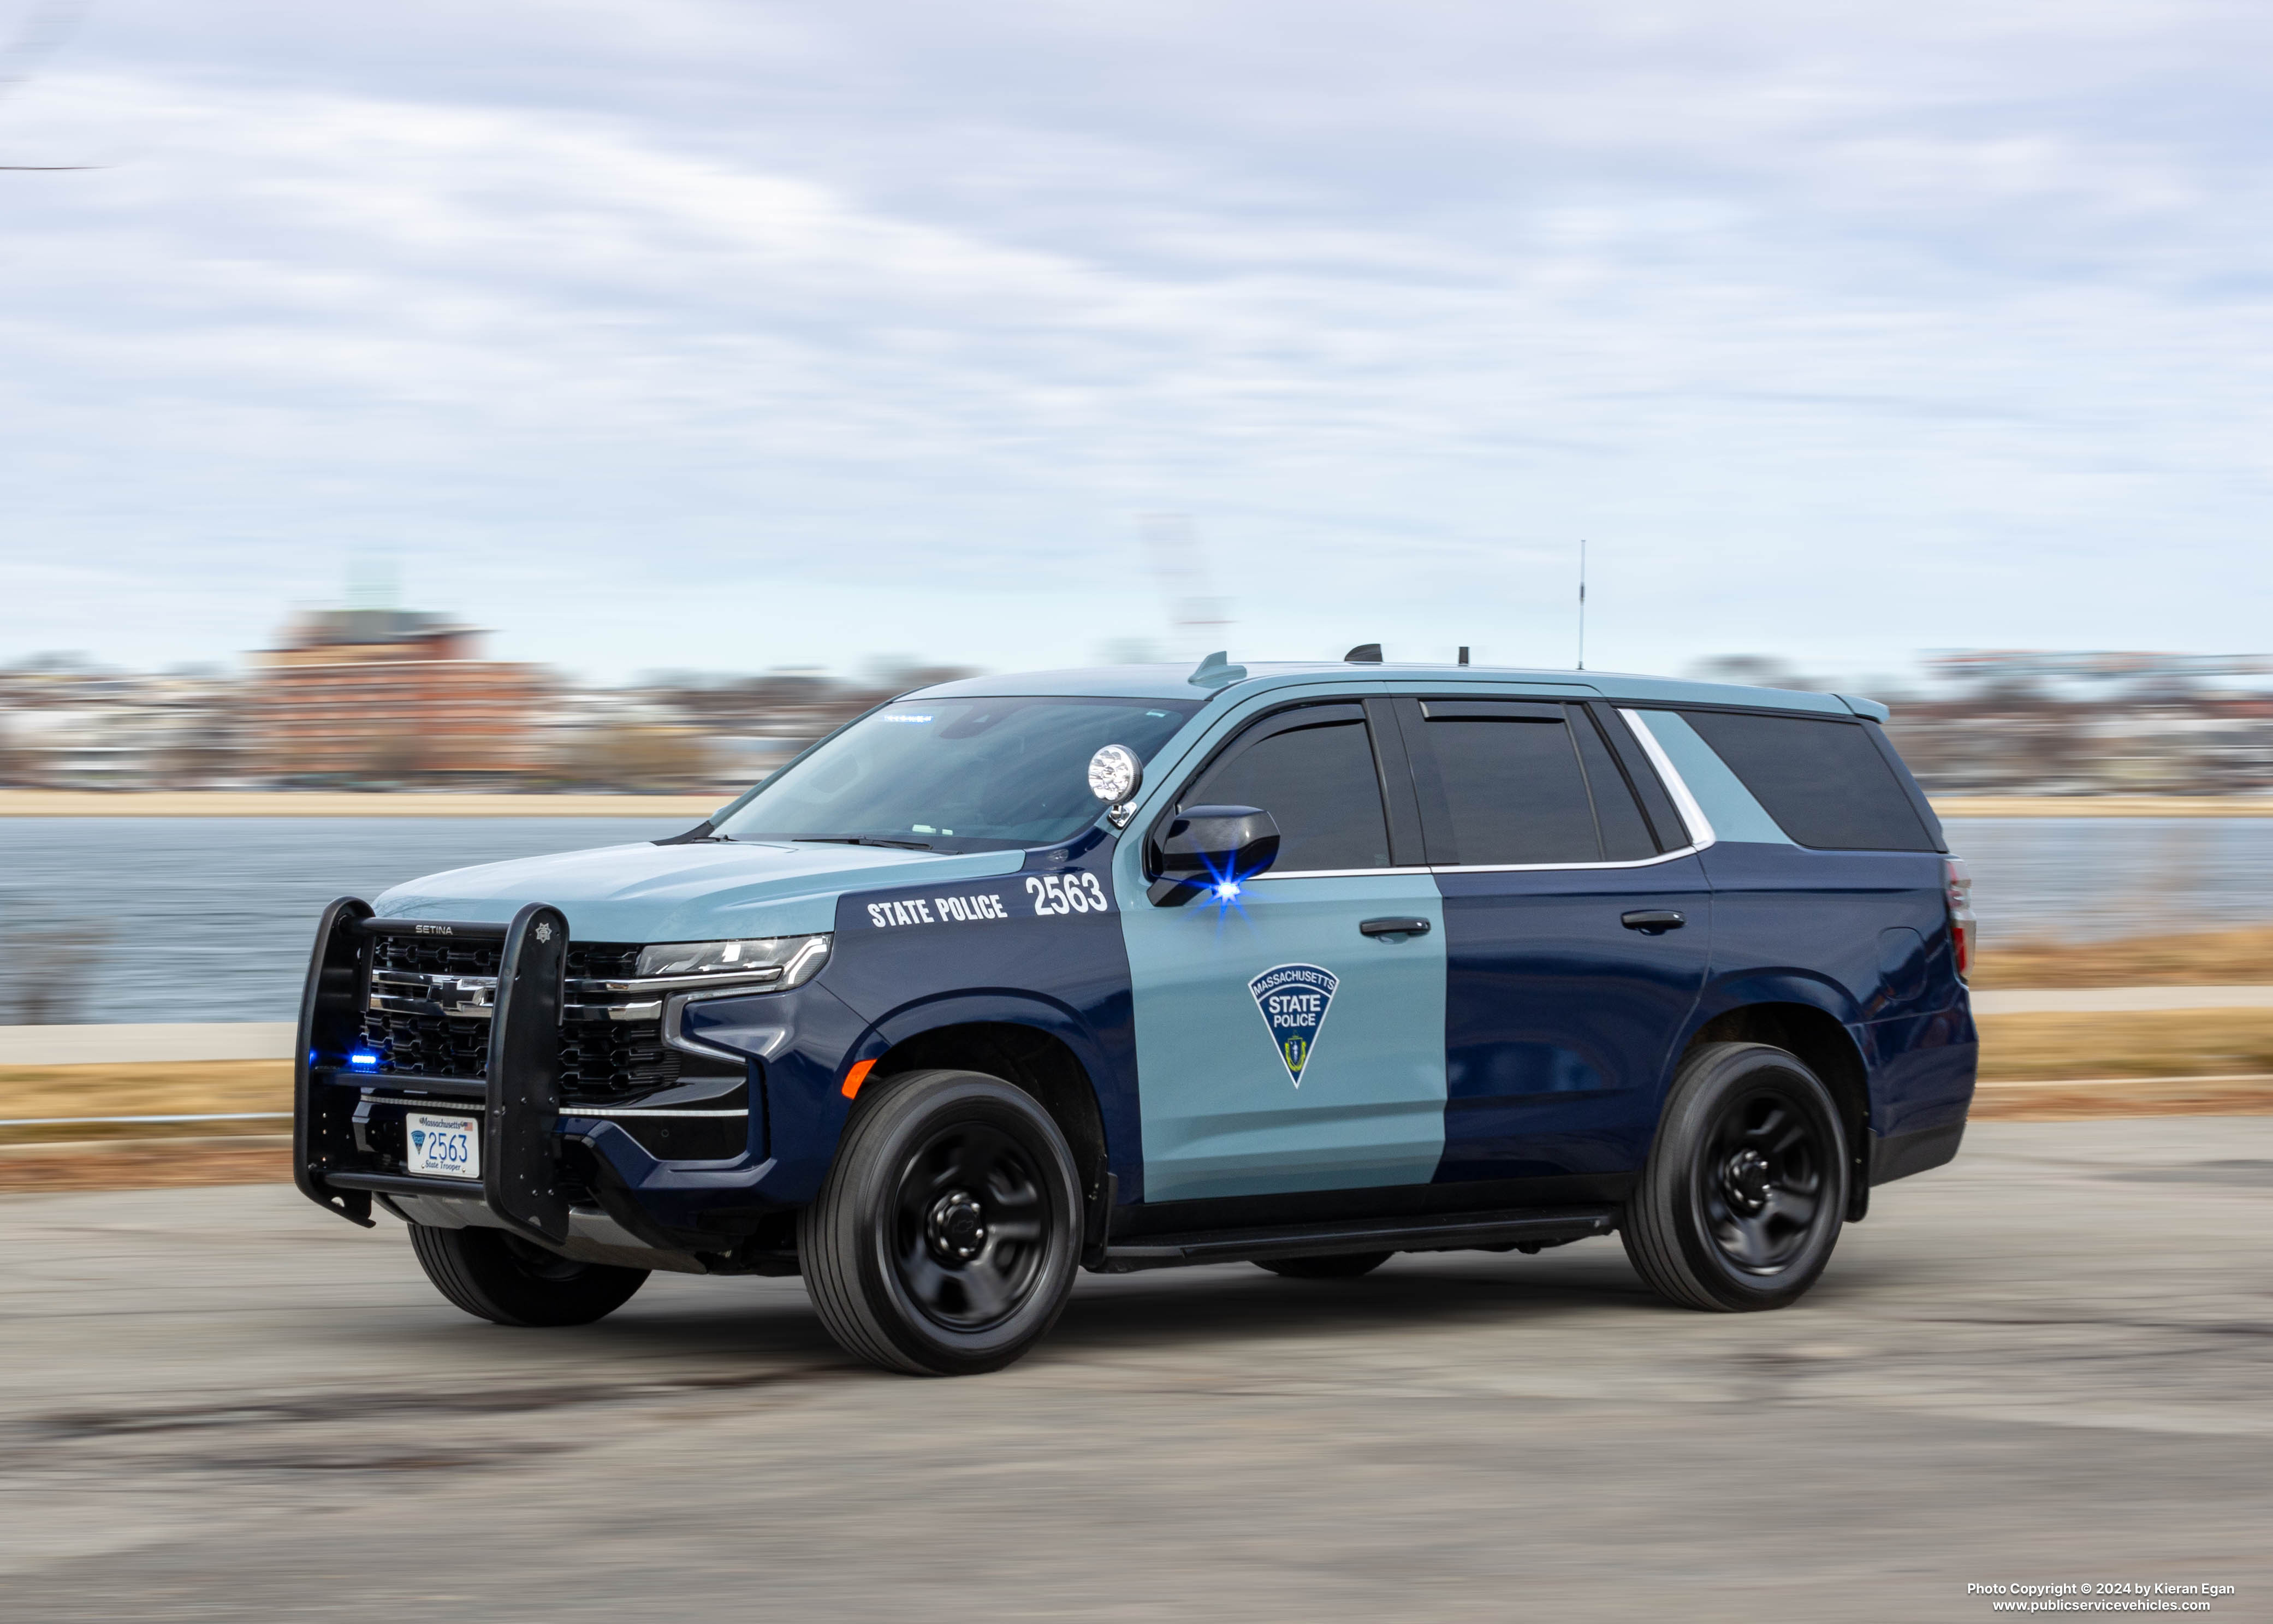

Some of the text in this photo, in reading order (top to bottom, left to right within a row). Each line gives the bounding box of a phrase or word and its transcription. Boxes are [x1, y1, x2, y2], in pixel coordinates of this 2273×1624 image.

[868, 872, 1108, 928] STATE POLICE 2563
[416, 924, 453, 935] SETINA
[1253, 970, 1336, 996] MASSACHUSETTS
[1269, 994, 1321, 1013] STATE
[1274, 1013, 1316, 1028] POLICE
[422, 1117, 461, 1129] Massachusetts
[429, 1131, 468, 1163] 2563
[425, 1160, 461, 1172] State Trooper
